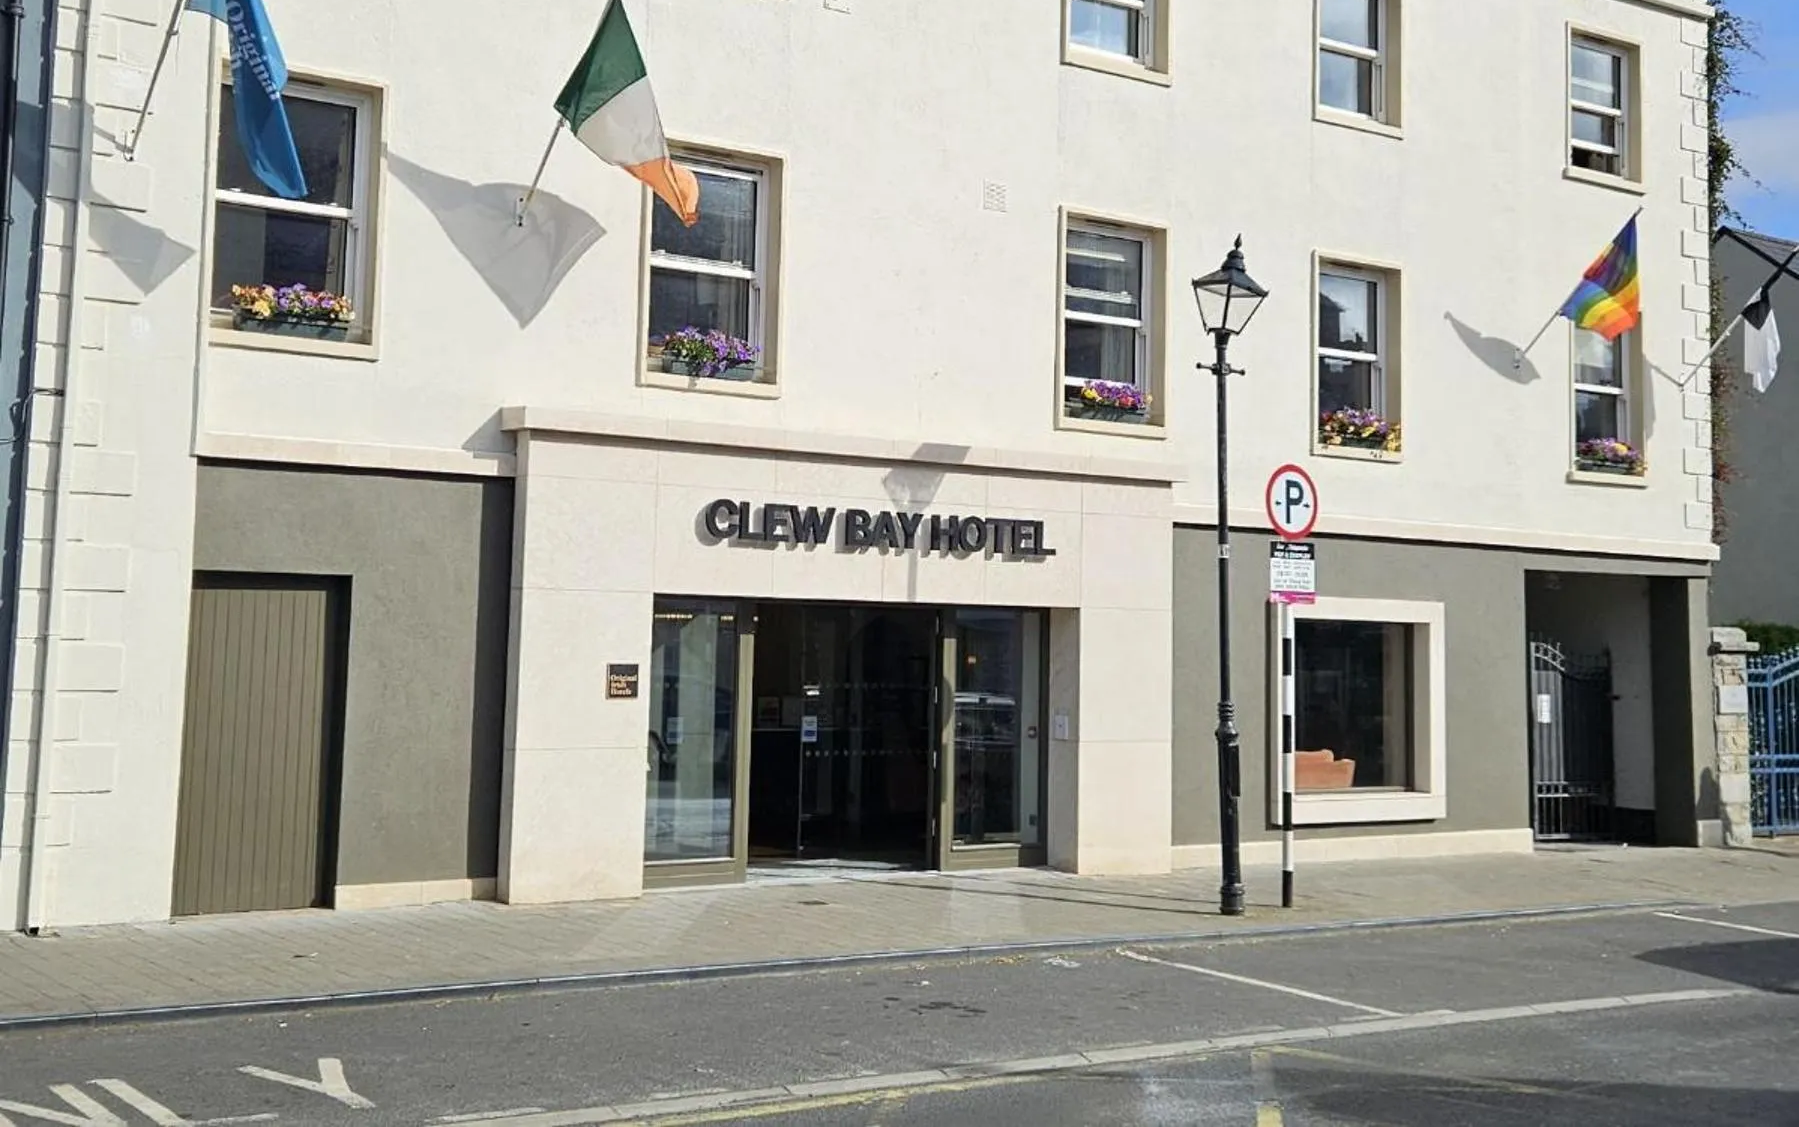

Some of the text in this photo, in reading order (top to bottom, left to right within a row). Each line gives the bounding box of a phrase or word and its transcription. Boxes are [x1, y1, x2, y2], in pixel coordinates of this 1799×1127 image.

[226, 0, 281, 101] Original
[705, 498, 1057, 556] CLEW BAY HOTEL
[1286, 479, 1304, 524] P
